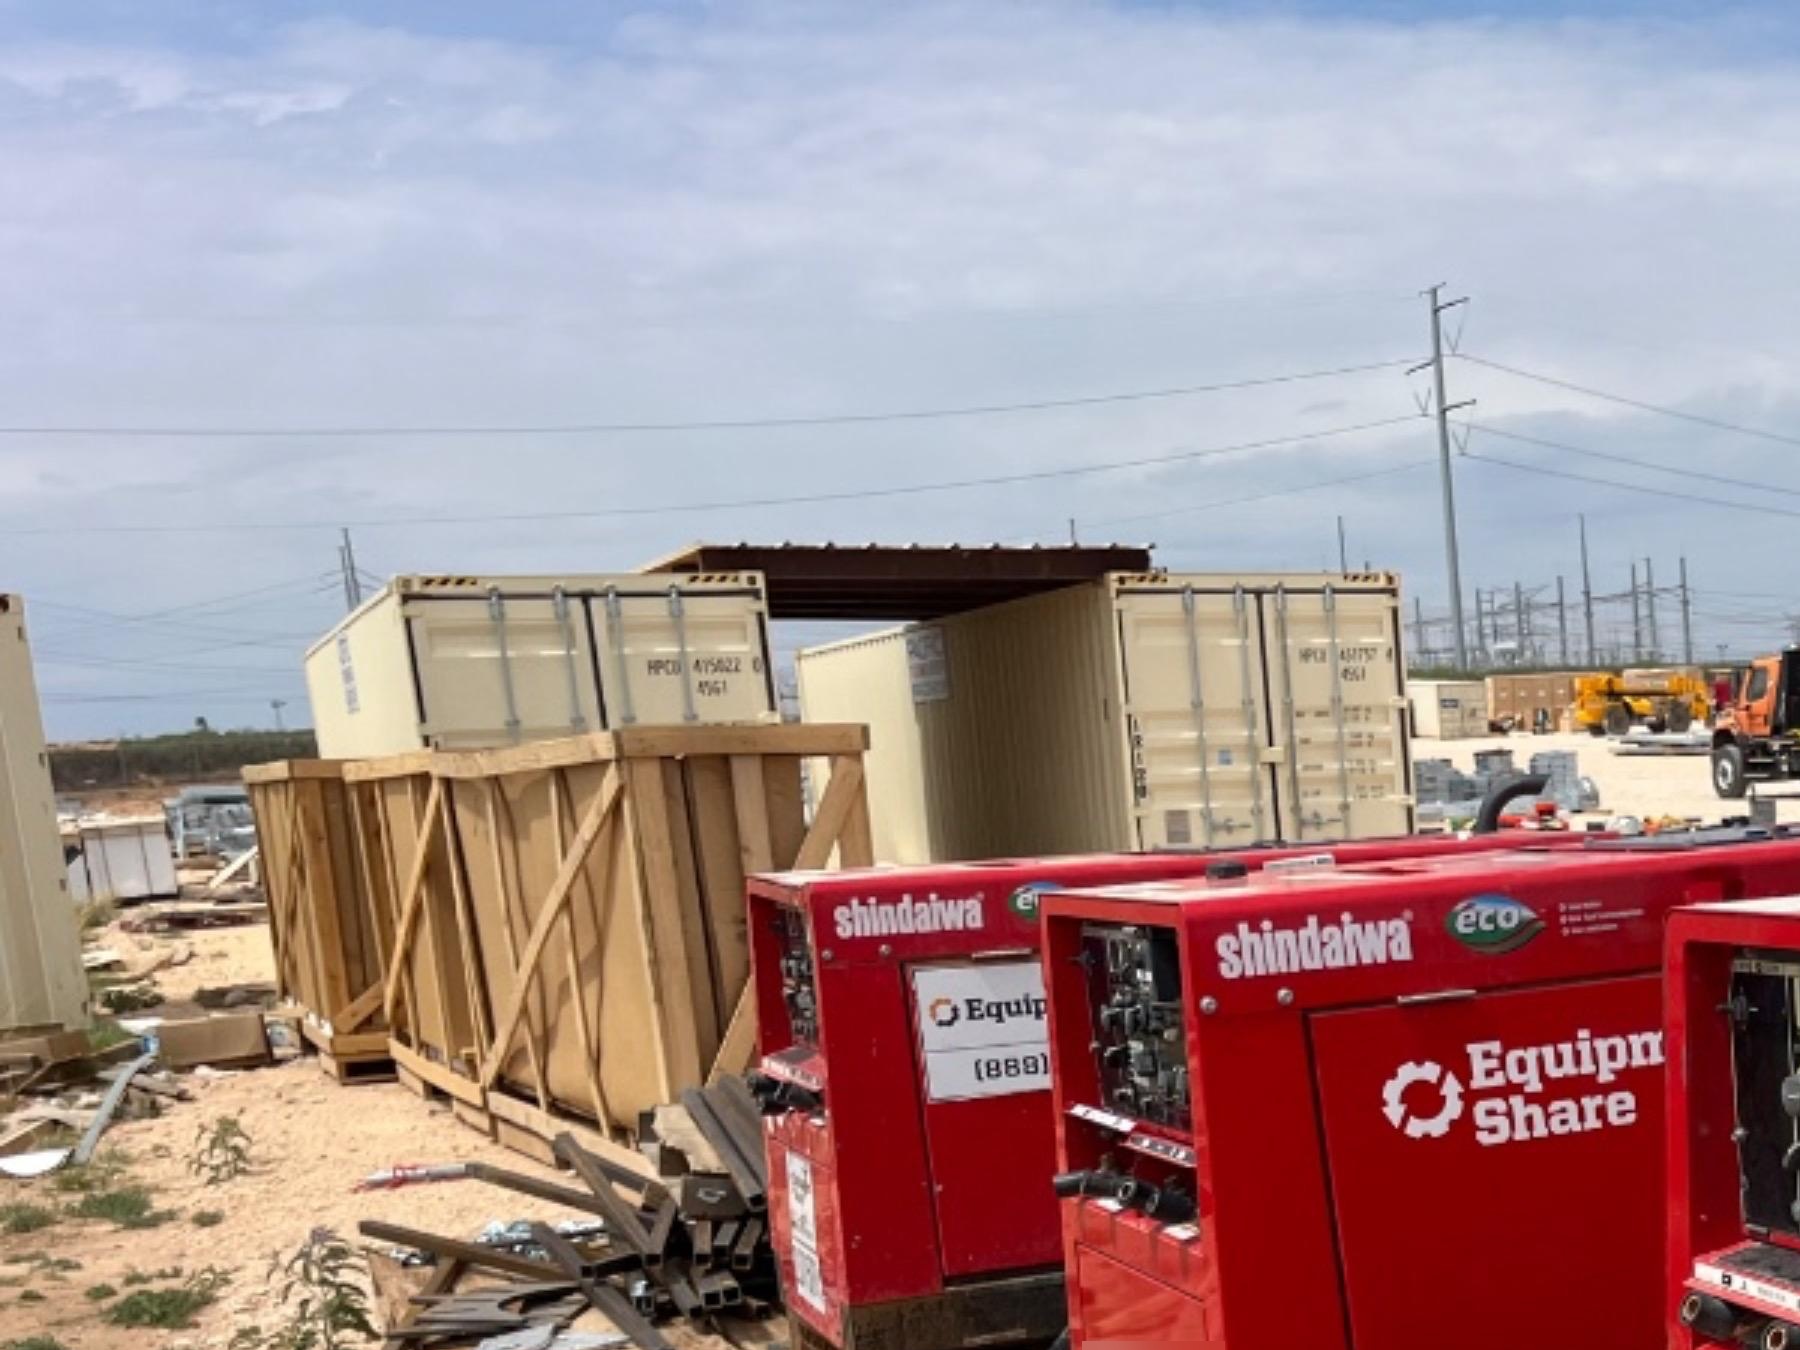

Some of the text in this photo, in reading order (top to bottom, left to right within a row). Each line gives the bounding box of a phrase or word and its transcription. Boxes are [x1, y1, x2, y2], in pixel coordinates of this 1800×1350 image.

[834, 893, 983, 939] shindaiwa
[1216, 911, 1412, 979] shindaiwa
[1472, 1090, 1637, 1146] Share
